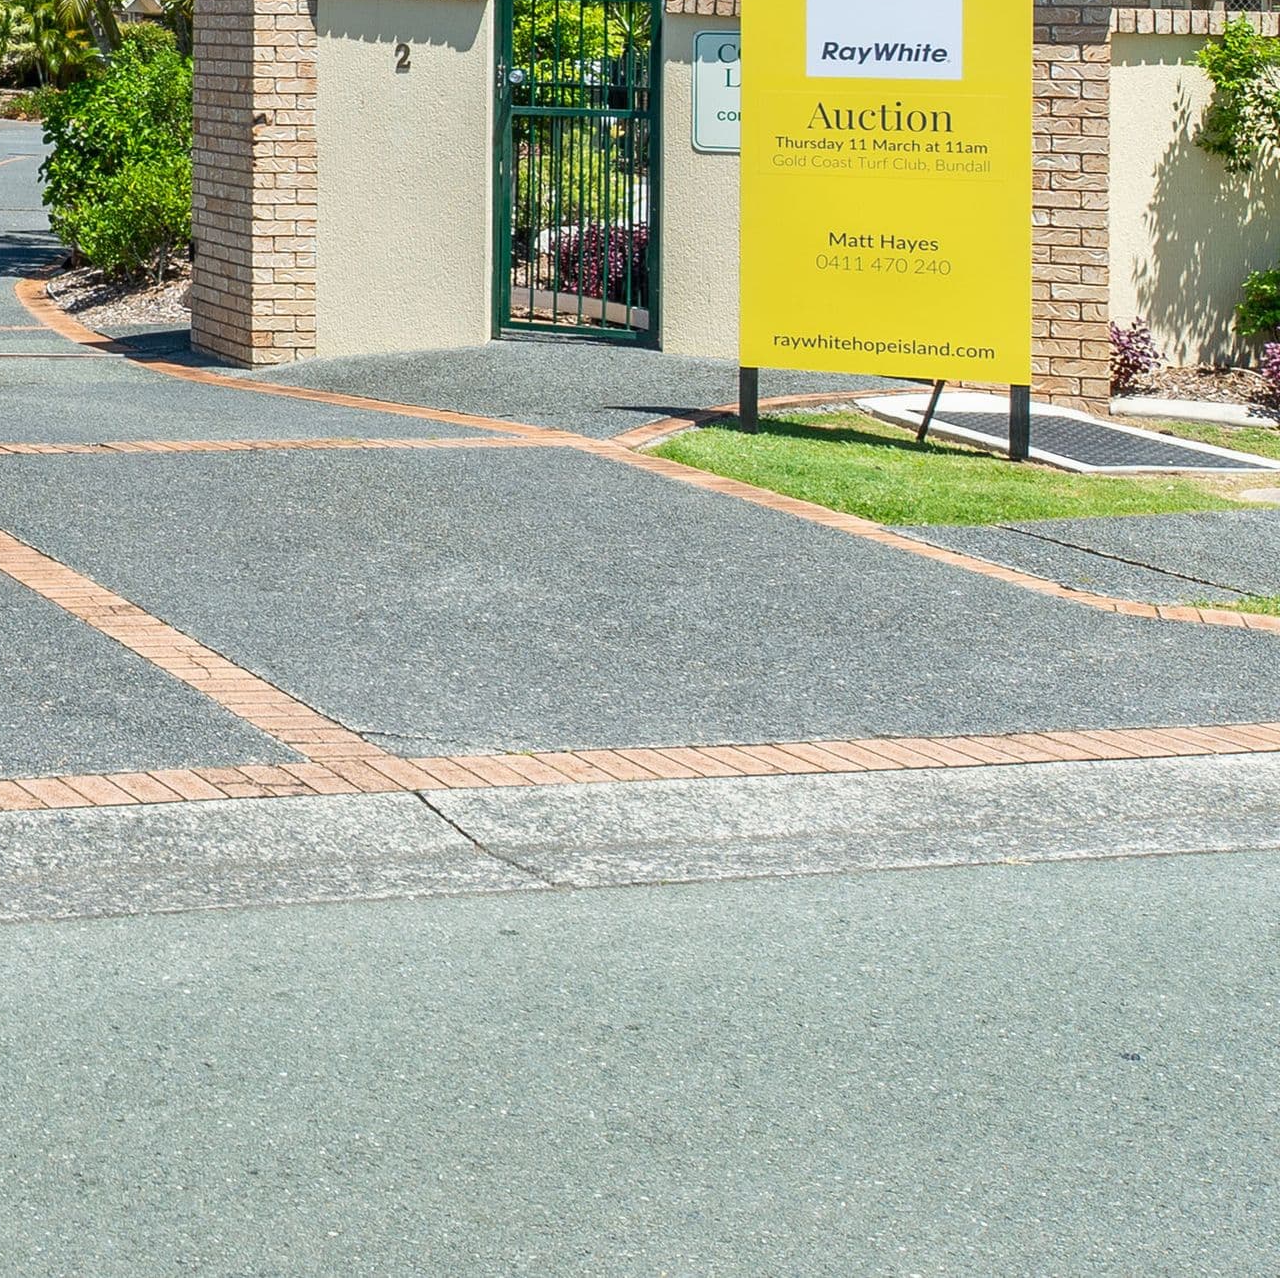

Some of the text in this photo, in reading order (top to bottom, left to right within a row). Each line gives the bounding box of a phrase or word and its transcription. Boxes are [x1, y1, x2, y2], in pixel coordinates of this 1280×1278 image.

[394, 43, 411, 70] 2
[807, 101, 954, 133] Auction
[775, 136, 988, 154] Thursday 11 March at 11am
[772, 154, 991, 173] Gold Coast Turf Club, Bundall
[829, 232, 939, 253] Matt Hayes
[815, 254, 951, 275] 0411 470 240
[773, 334, 995, 359] raywhitehopeisland.com
